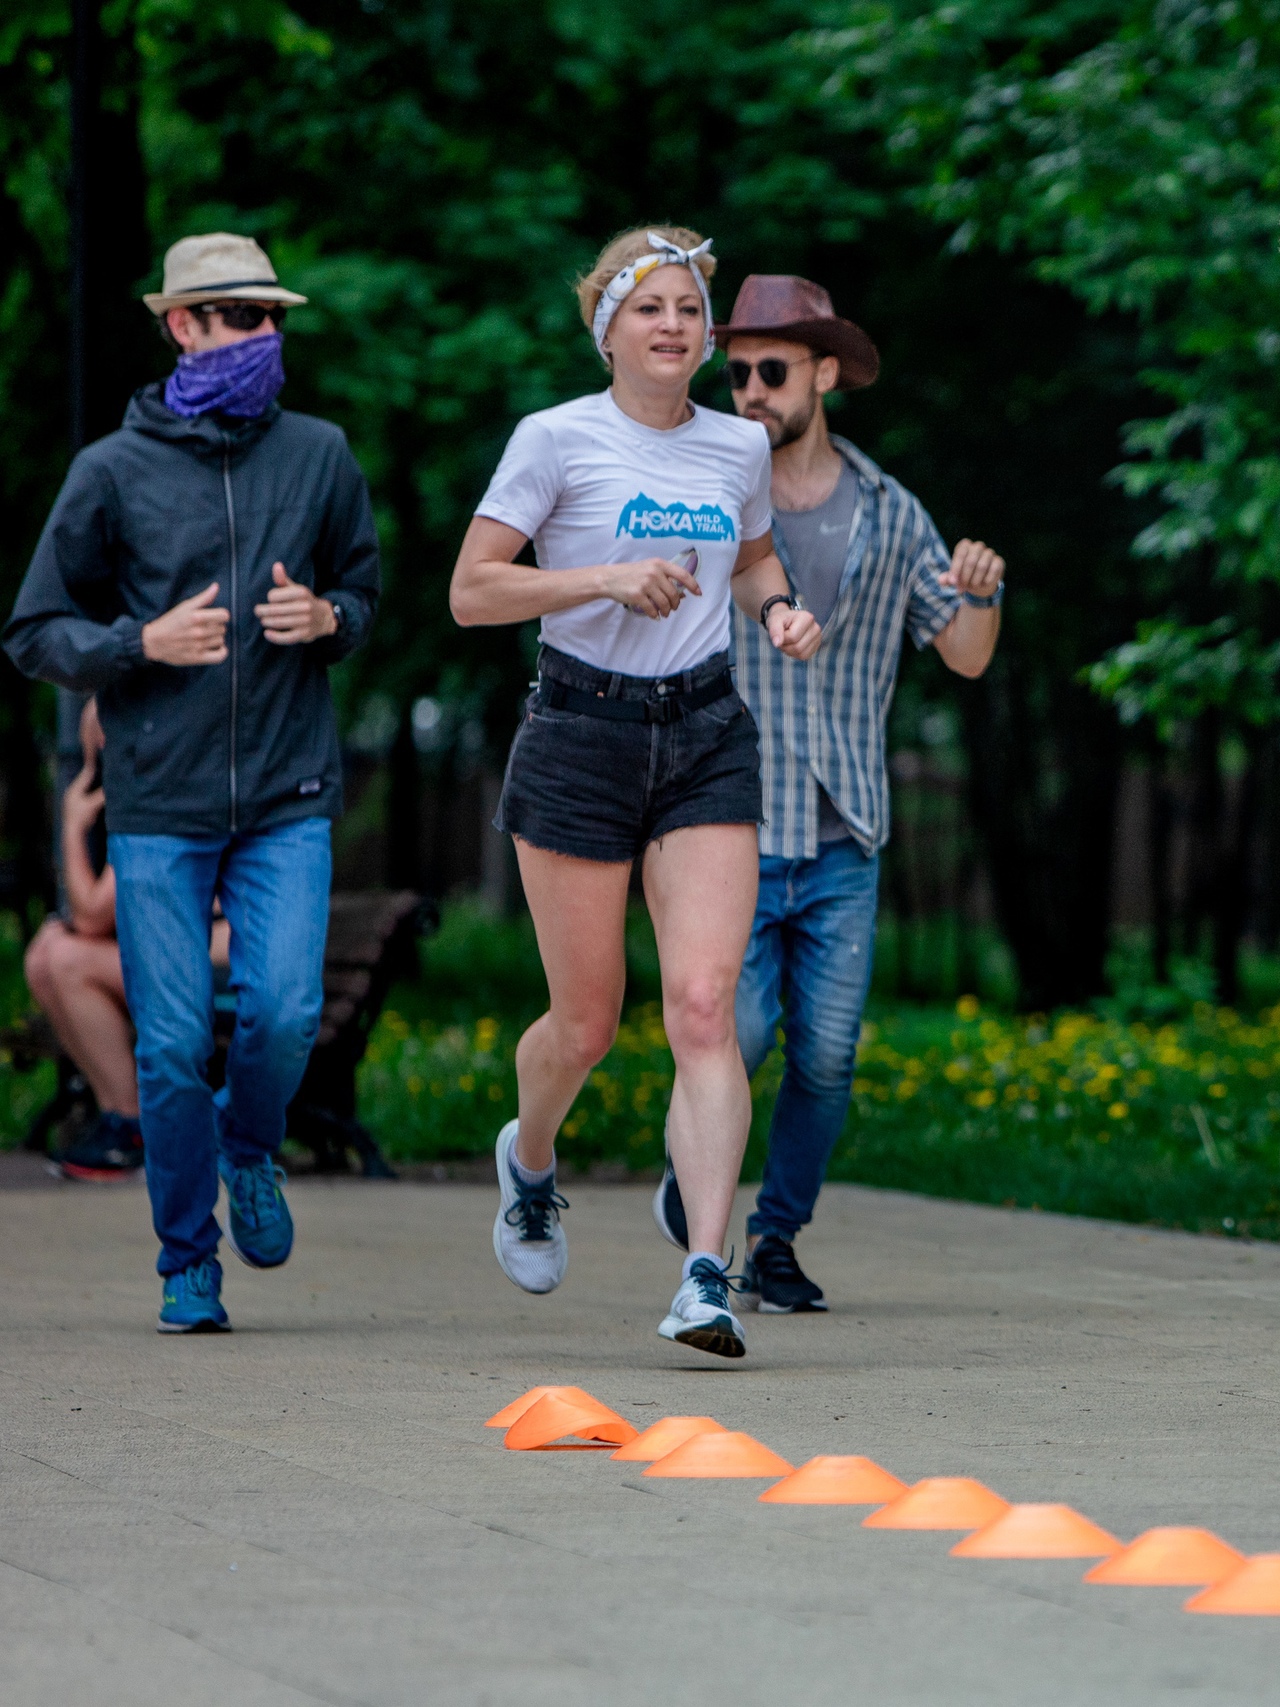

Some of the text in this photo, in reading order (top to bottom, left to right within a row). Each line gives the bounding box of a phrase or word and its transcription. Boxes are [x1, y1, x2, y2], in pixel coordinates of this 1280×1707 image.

[628, 510, 694, 532] HOKA
[692, 513, 720, 523] WILD
[697, 522, 726, 533] TRAIL
